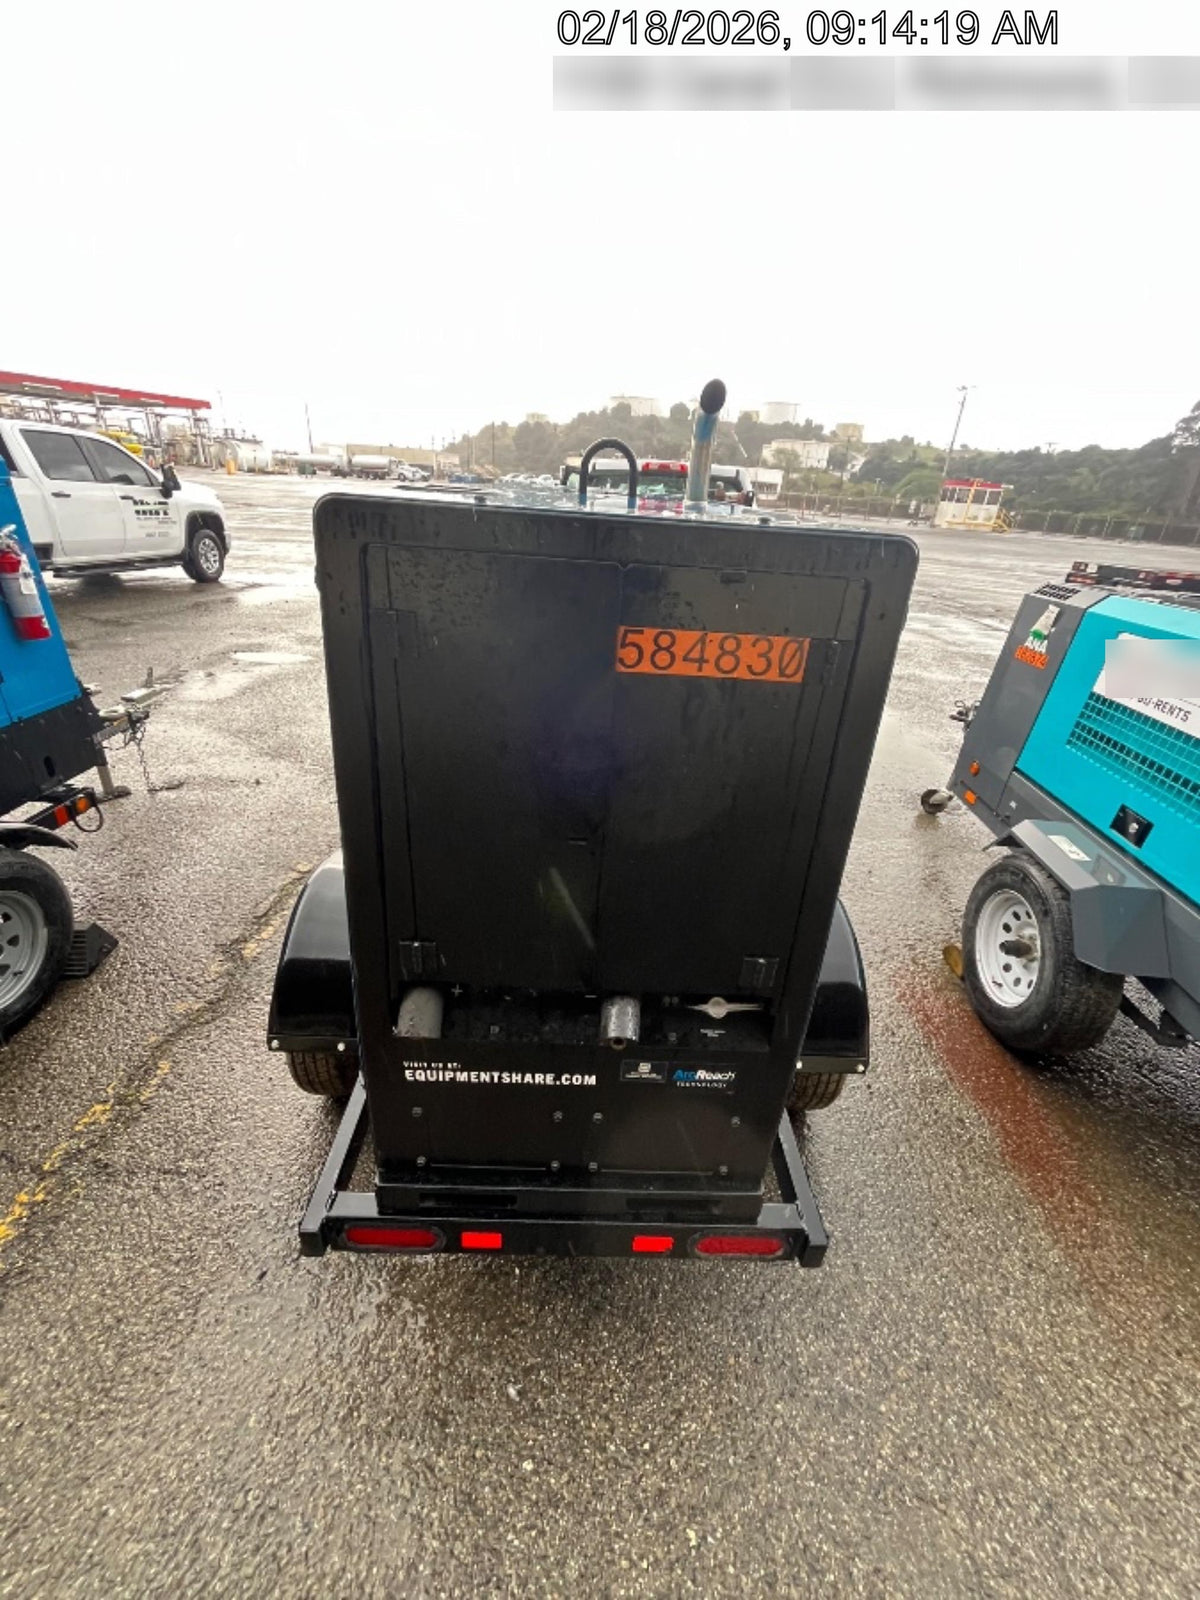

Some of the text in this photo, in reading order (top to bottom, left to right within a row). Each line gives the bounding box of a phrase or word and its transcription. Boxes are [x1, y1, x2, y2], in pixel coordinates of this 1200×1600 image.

[617, 628, 804, 679] 584830
[403, 1061, 428, 1069] VISIT
[404, 1069, 597, 1086] EQUIPMENTSHARE.COM
